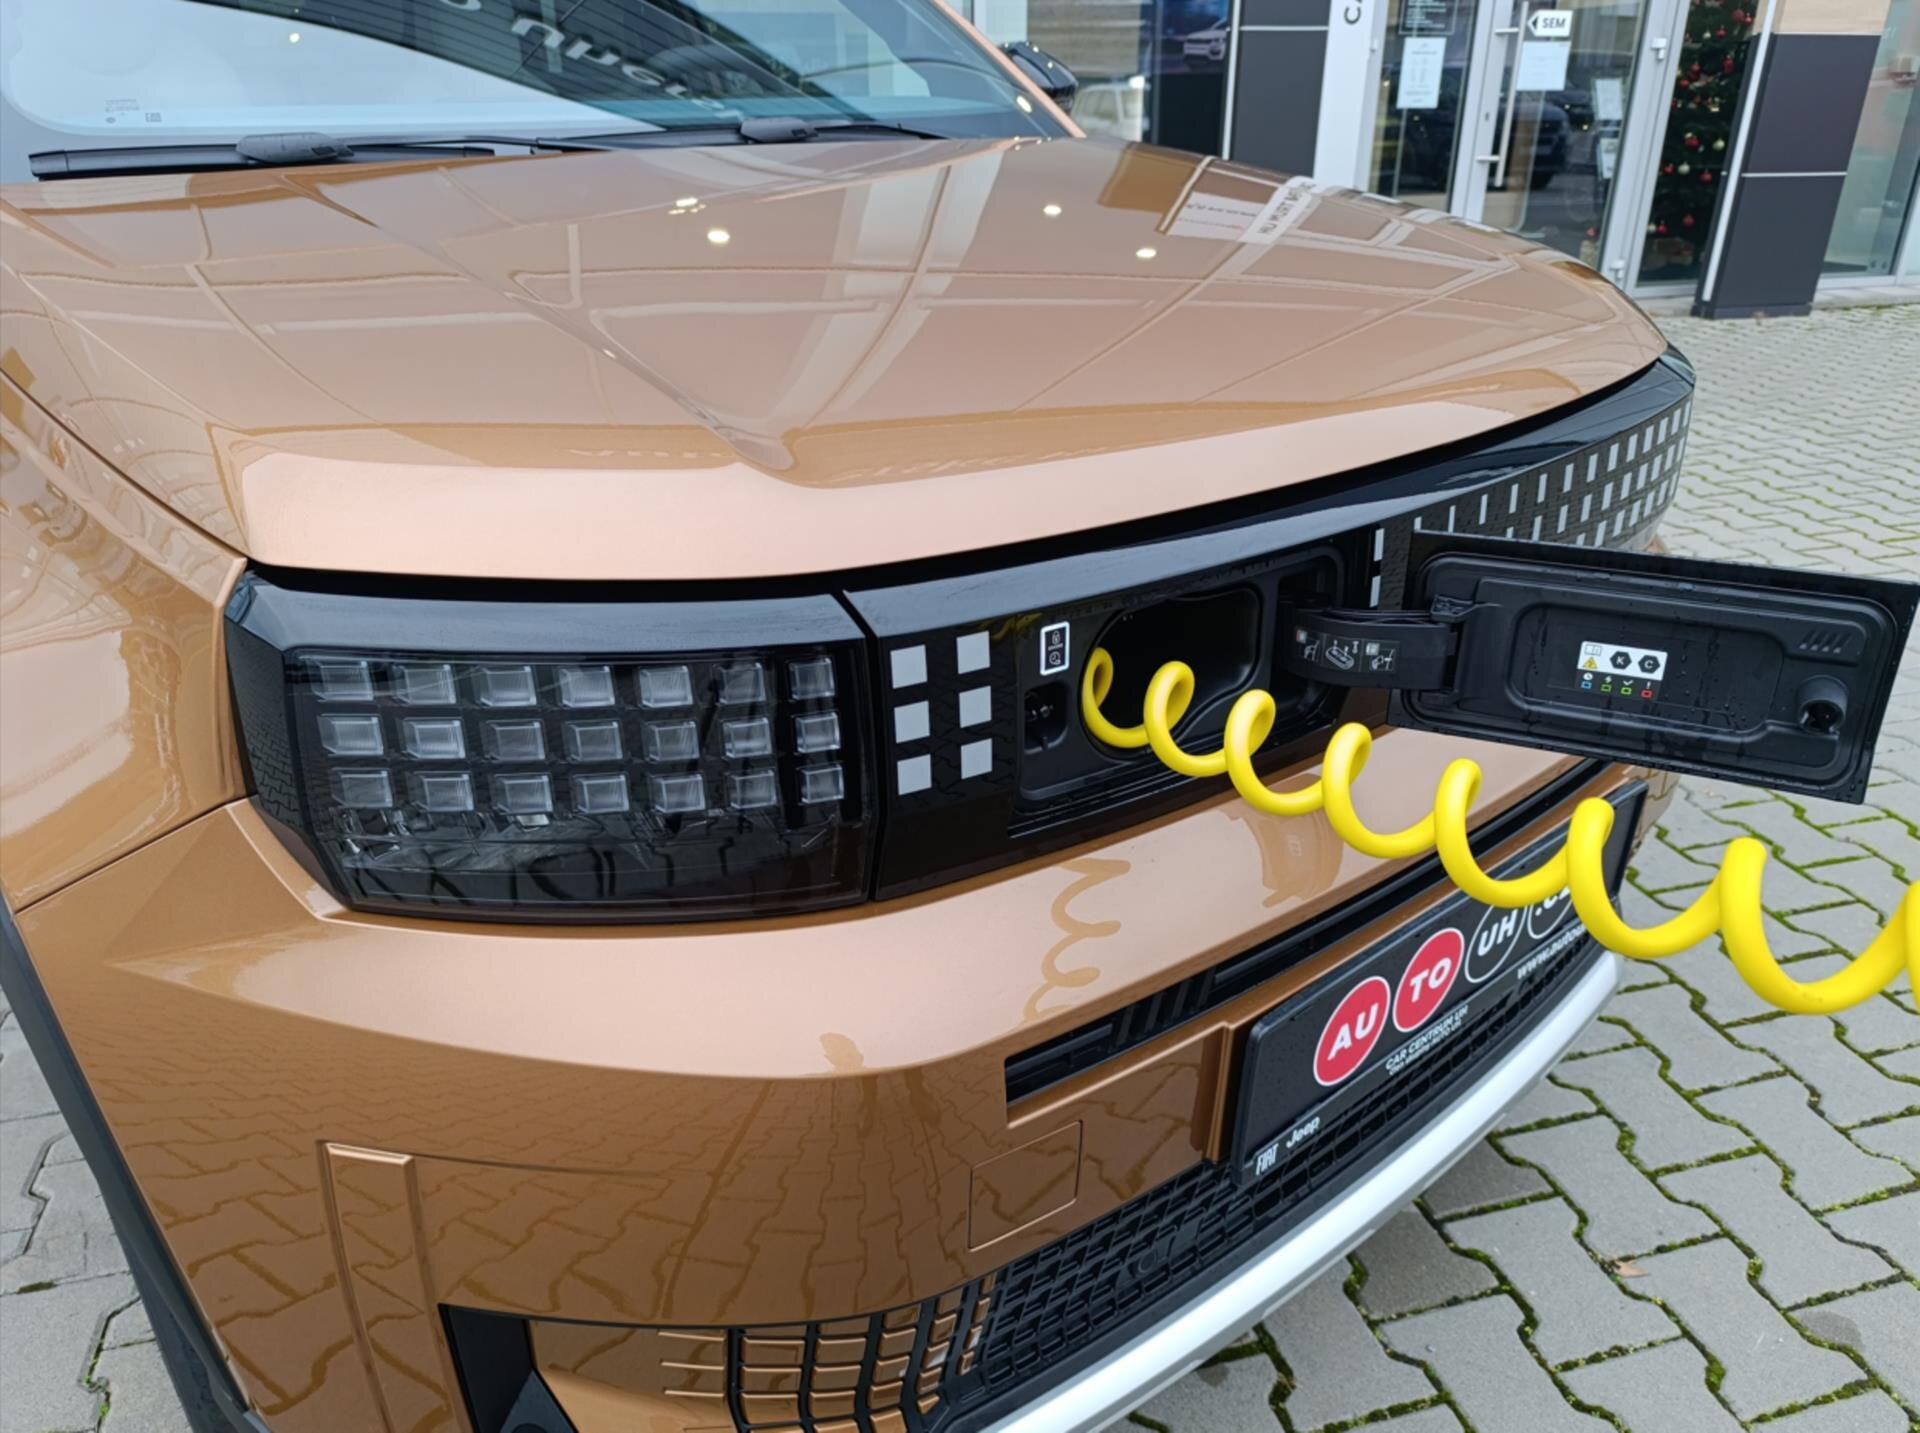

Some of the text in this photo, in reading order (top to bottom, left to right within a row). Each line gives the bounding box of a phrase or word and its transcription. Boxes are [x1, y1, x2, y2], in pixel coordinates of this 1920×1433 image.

[1542, 17, 1566, 29] SEM
[1616, 656, 1625, 665] K
[1644, 660, 1654, 669] C
[1327, 1002, 1379, 1061] AU
[1409, 957, 1452, 1003] TO
[1477, 908, 1519, 957] UH
[1385, 1048, 1407, 1070] CAR
[1255, 1116, 1321, 1176] FIAT Jeep
